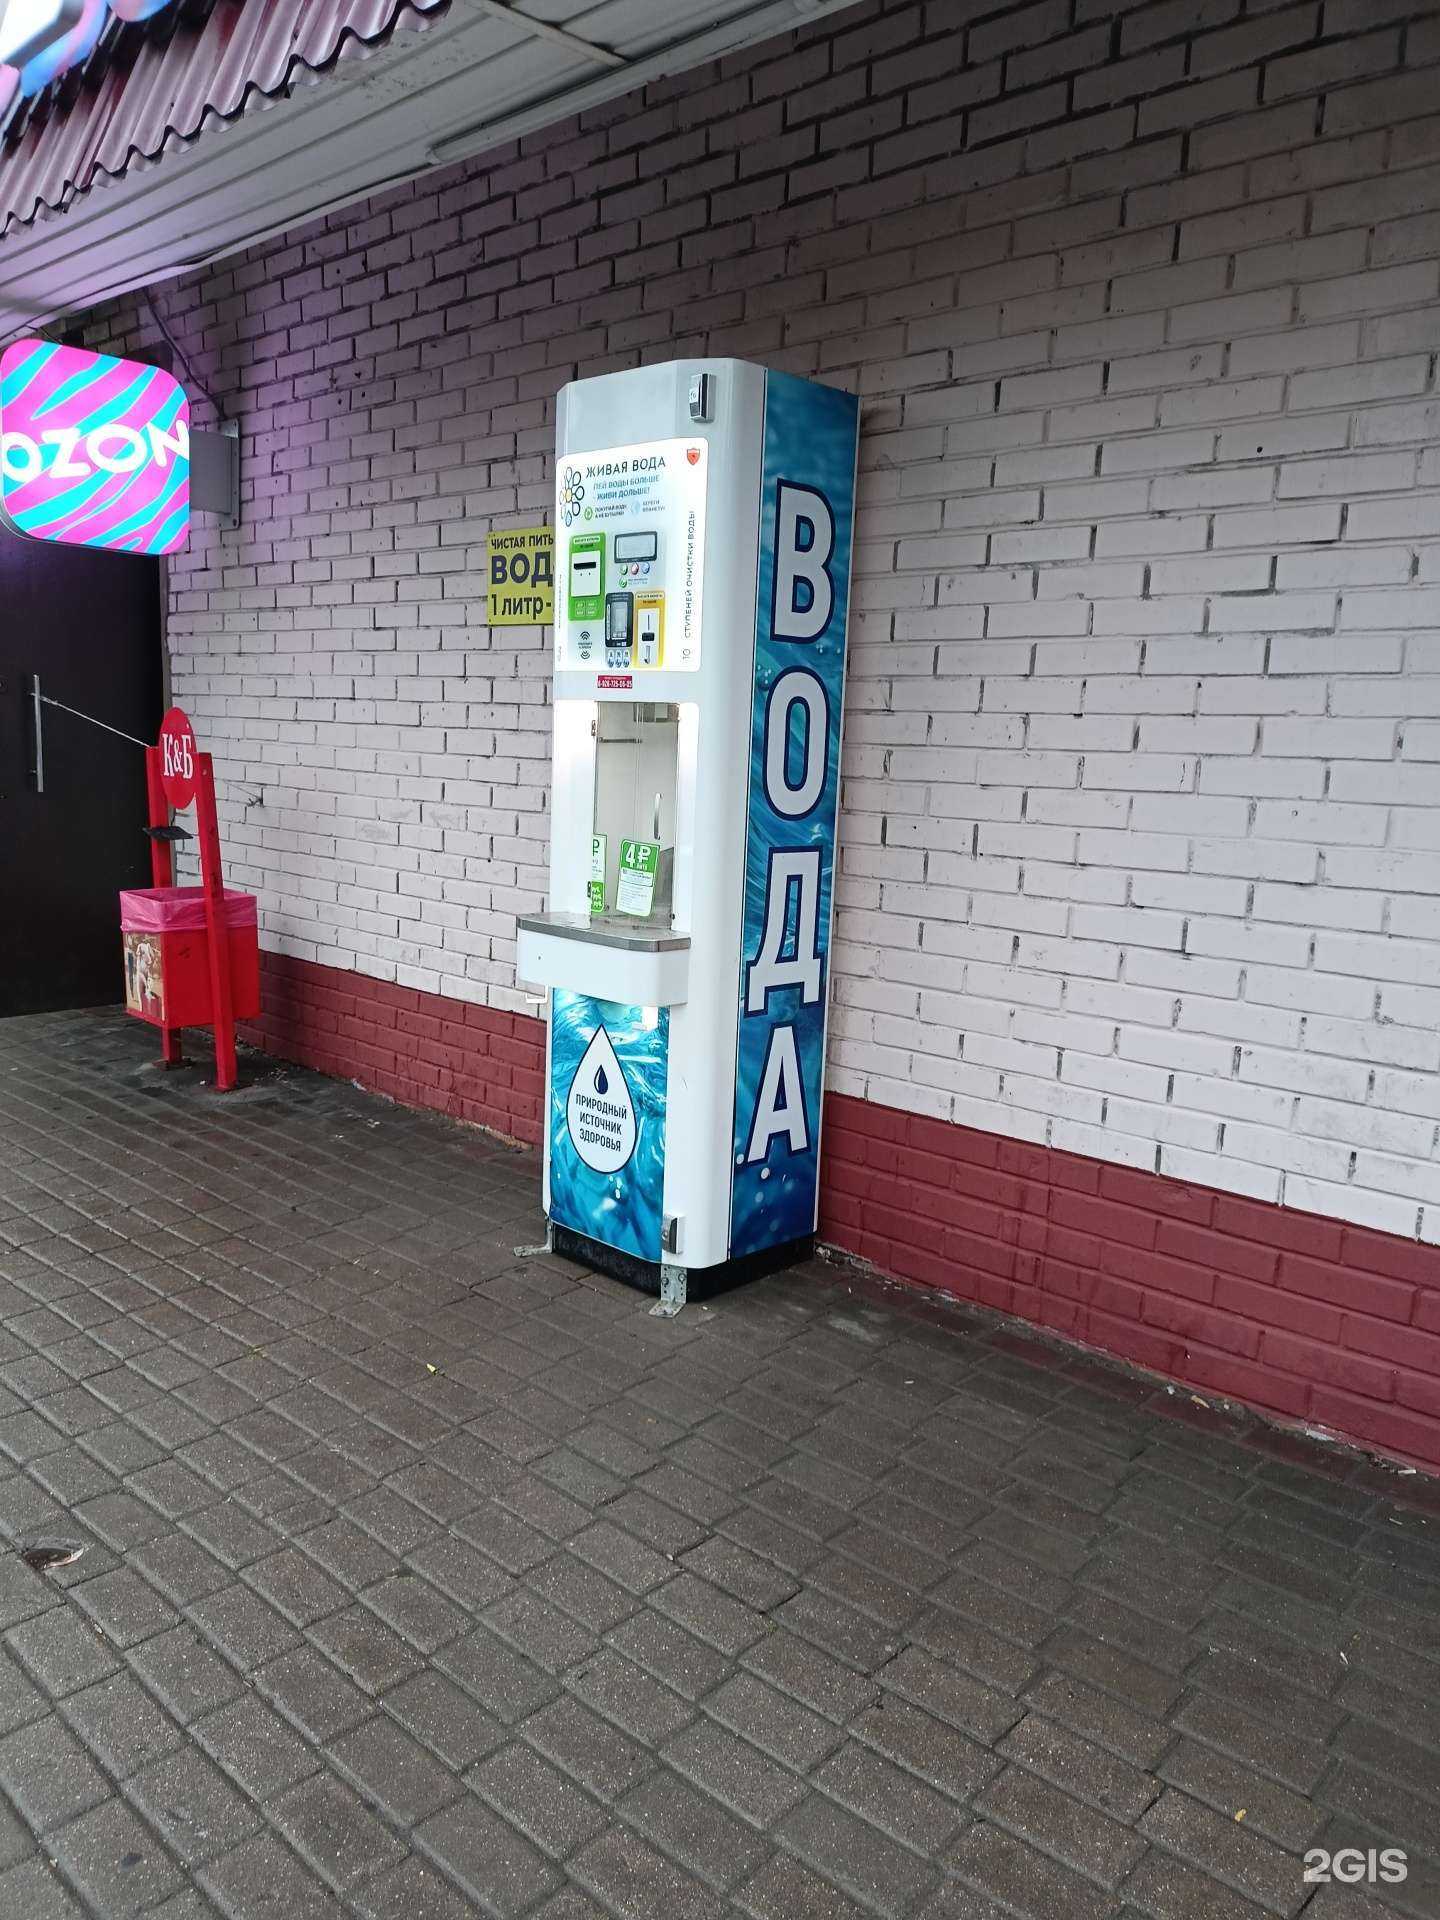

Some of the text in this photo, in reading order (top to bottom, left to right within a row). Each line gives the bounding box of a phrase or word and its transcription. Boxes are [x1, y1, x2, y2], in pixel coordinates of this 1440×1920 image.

[1, 420, 189, 483] OZON
[586, 456, 666, 478] ЖИВАЯ ВОДА
[608, 478, 629, 489] ВОДЫ
[630, 475, 660, 486] БОЛЬШЕ
[491, 535, 526, 550] ЧИСТАЯ
[491, 551, 555, 588] ВОД
[686, 542, 694, 587] ОЧИСТКИ
[684, 590, 693, 639] СТУПЕНЕЙ
[162, 733, 194, 780] К&Б
[744, 478, 835, 1167] ВОДА
[576, 1093, 627, 1120] ПРИРОДНЫЙ
[579, 1112, 622, 1136] ИСТОЧНИК
[579, 1128, 621, 1152] ЗДОРОВЬЯ
